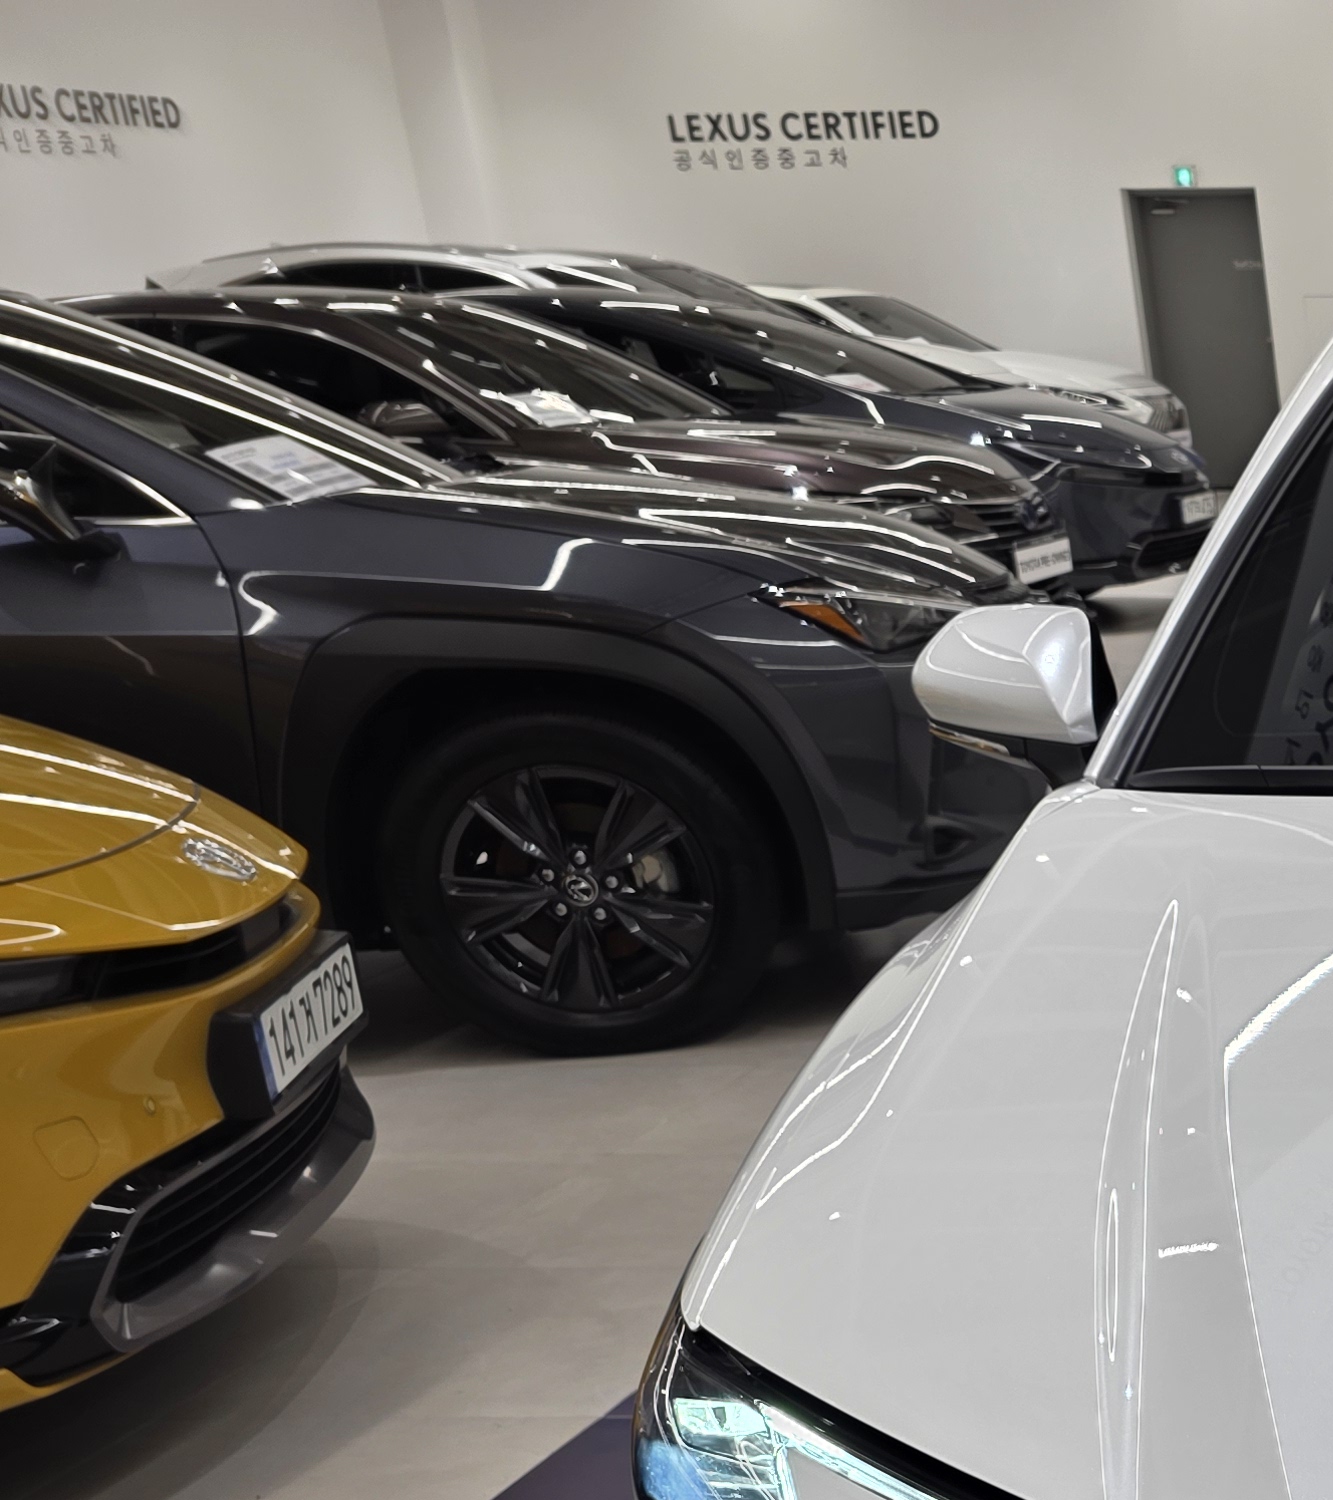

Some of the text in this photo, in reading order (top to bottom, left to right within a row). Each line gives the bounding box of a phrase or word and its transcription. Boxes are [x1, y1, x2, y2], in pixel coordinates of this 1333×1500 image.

[54, 87, 182, 129] CERTIFIED
[667, 109, 940, 142] LEXUS CERTIFIED
[269, 954, 356, 1077] 141거 7289
